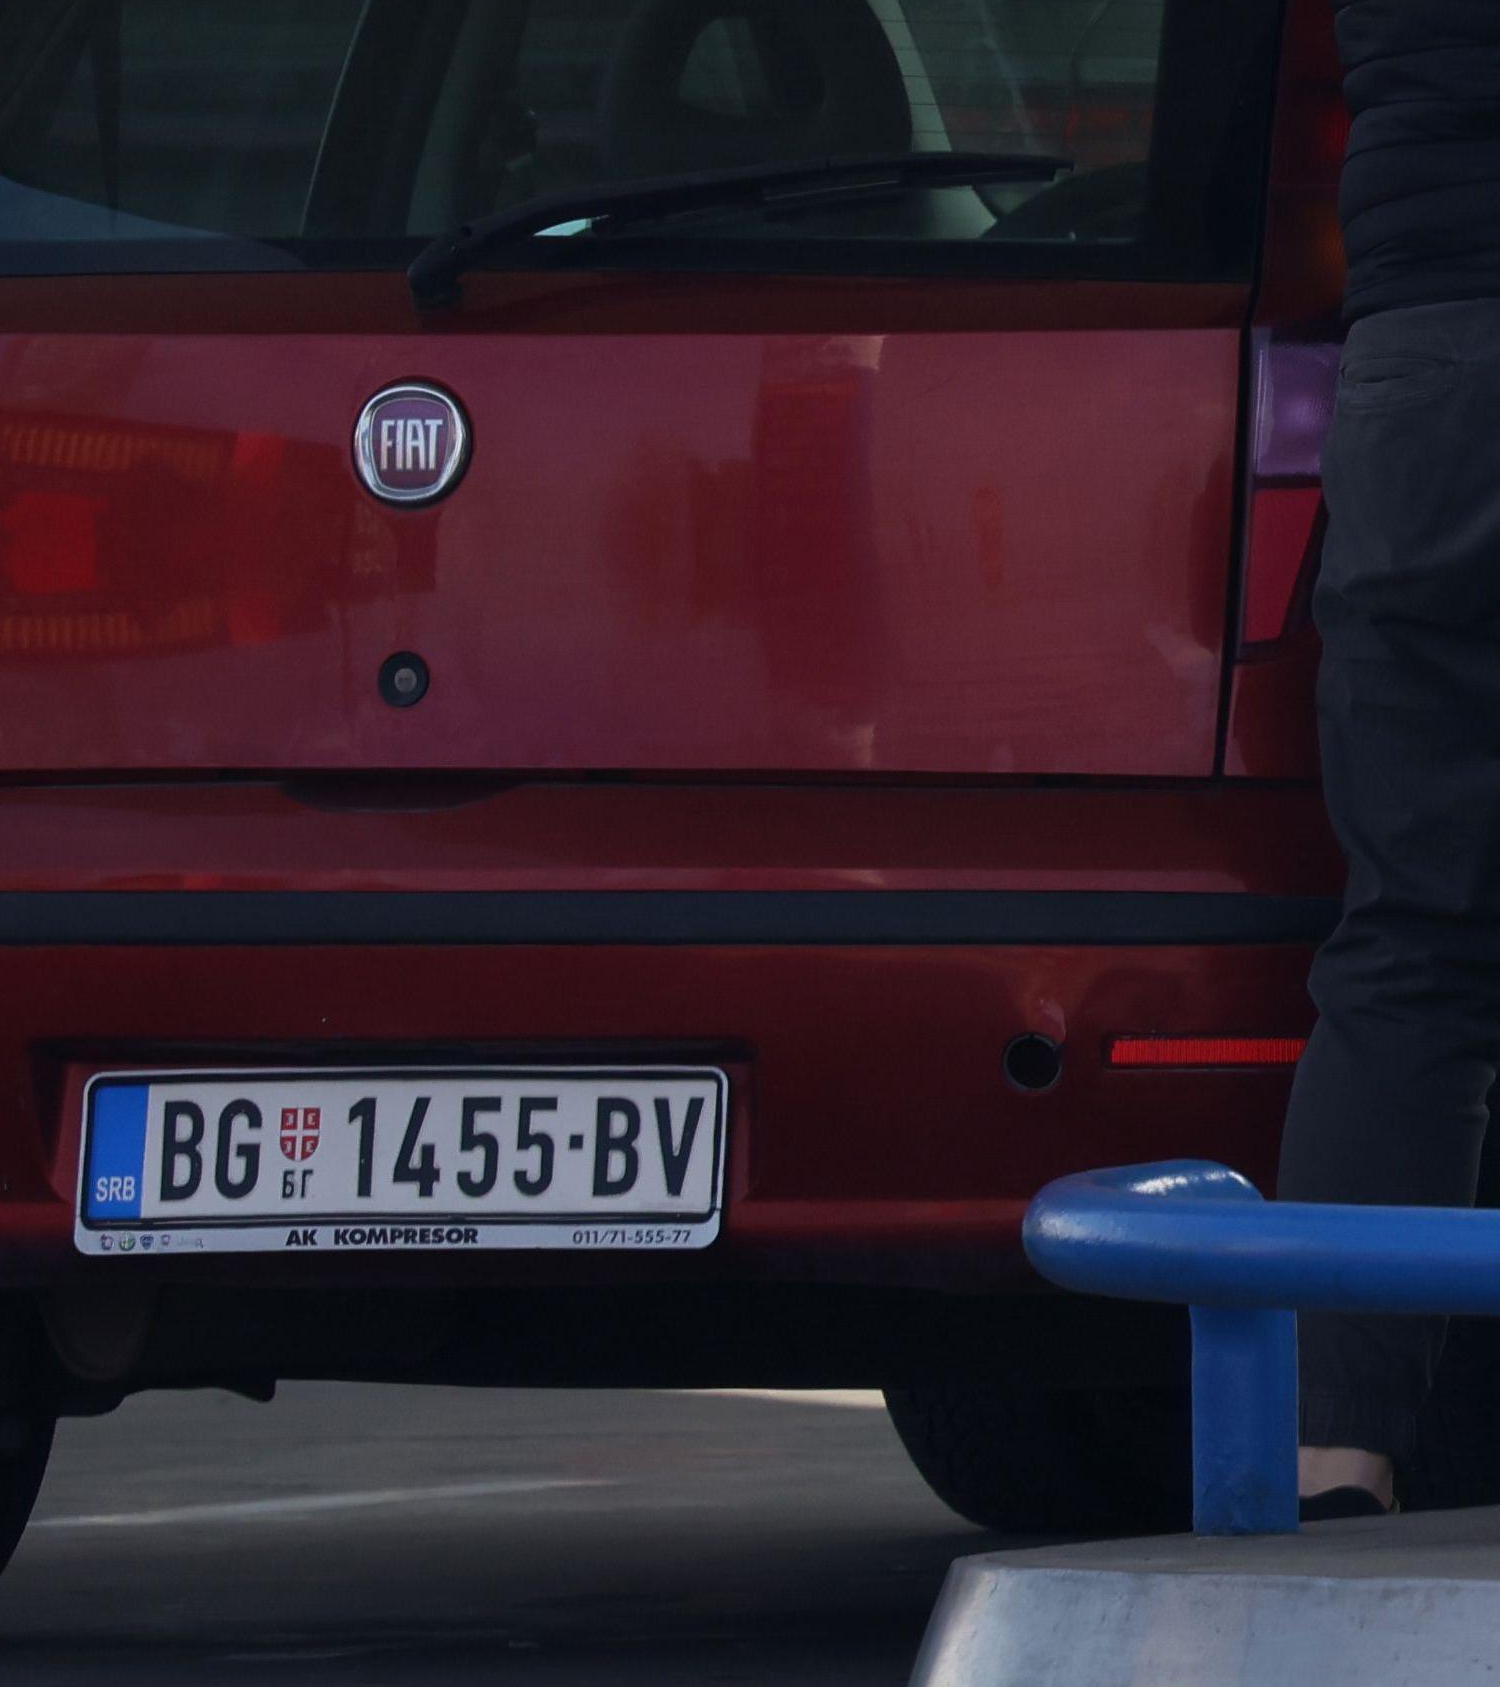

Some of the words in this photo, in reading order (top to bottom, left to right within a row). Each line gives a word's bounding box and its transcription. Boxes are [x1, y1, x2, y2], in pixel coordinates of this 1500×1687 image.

[381, 418, 443, 470] FIAT
[159, 1098, 263, 1202] BG
[96, 1177, 136, 1202] SRB
[285, 1229, 318, 1246] AK
[333, 1227, 479, 1246] KOMPRESOR
[572, 1228, 692, 1246] 011/71-555-77
